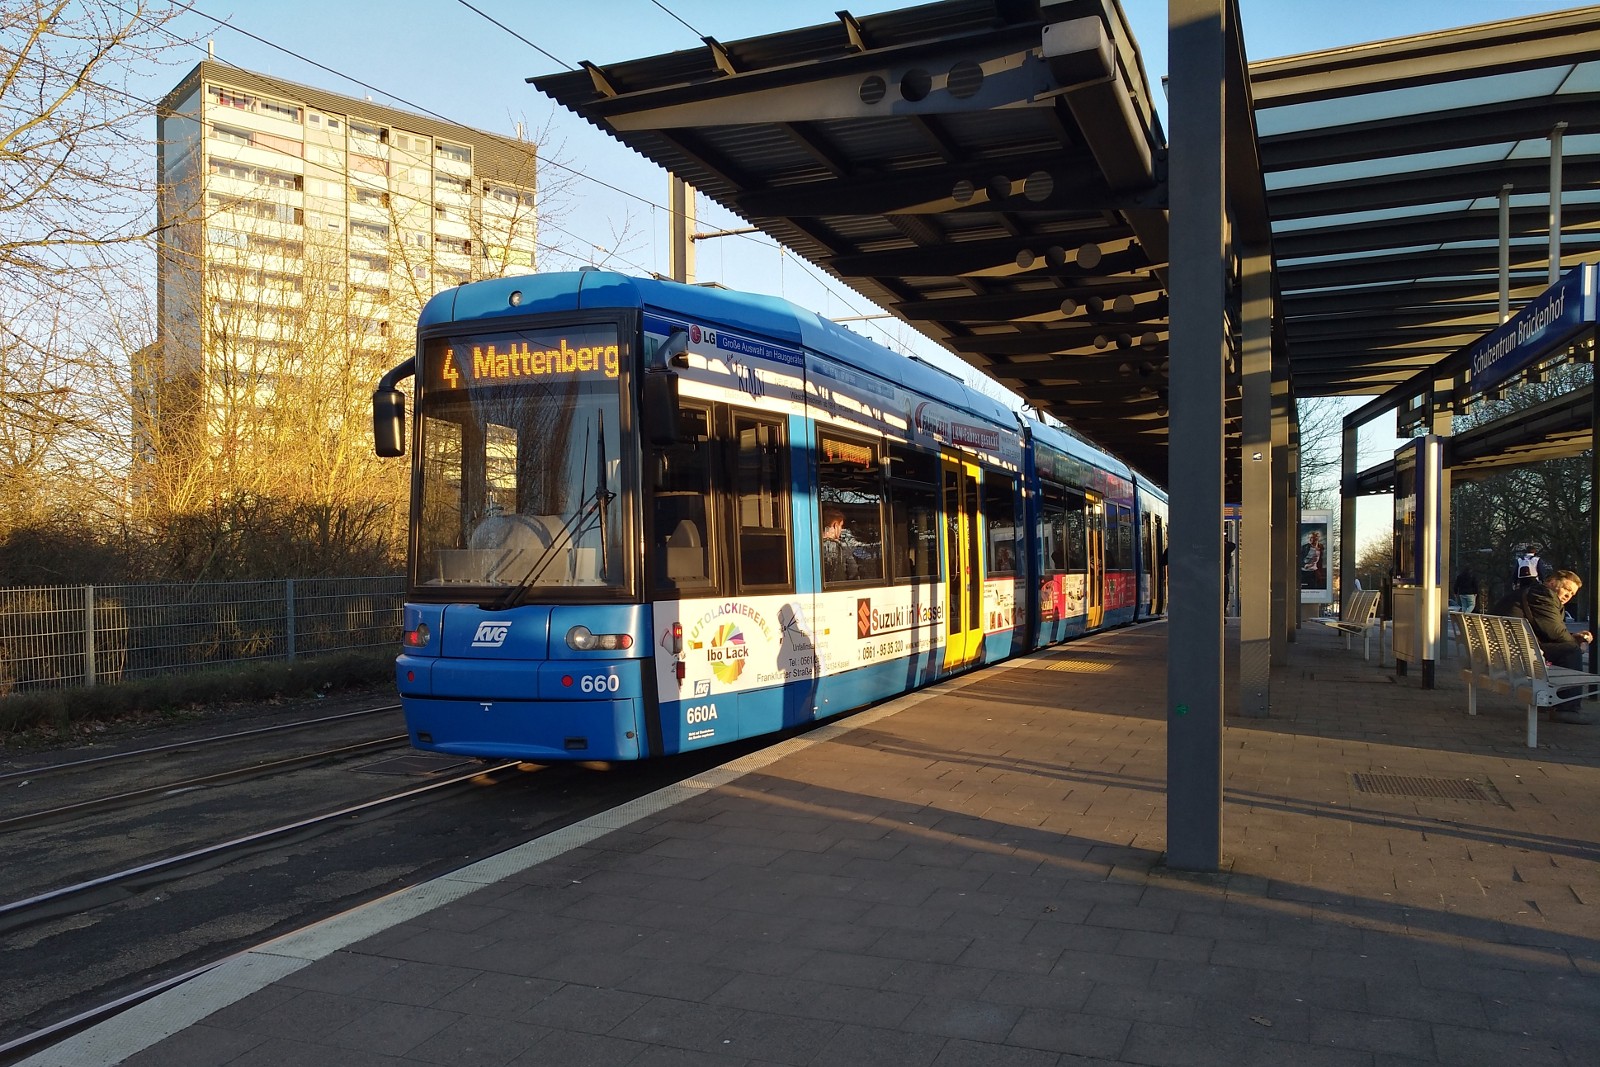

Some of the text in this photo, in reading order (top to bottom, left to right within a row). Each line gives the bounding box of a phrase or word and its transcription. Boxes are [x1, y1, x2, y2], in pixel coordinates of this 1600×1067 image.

[703, 330, 716, 345] LG
[1473, 286, 1566, 376] Schulzentrum Brückenhof
[722, 337, 741, 351] Große
[742, 343, 765, 356] Auswahl
[766, 349, 773, 358] an
[443, 339, 620, 388] 4 Mattenberg
[871, 600, 944, 631] Suzuki in Kassel
[473, 624, 509, 643] KVG
[687, 602, 773, 651] AUTOLACKIEREREI
[706, 646, 749, 662] Ibo Lack
[800, 655, 813, 666] 0561
[862, 645, 876, 660] 0561
[580, 674, 620, 693] 660
[756, 670, 792, 682] Frankfurter
[792, 666, 813, 678] Straße
[695, 681, 710, 696] KVG
[686, 703, 718, 724] 660A
